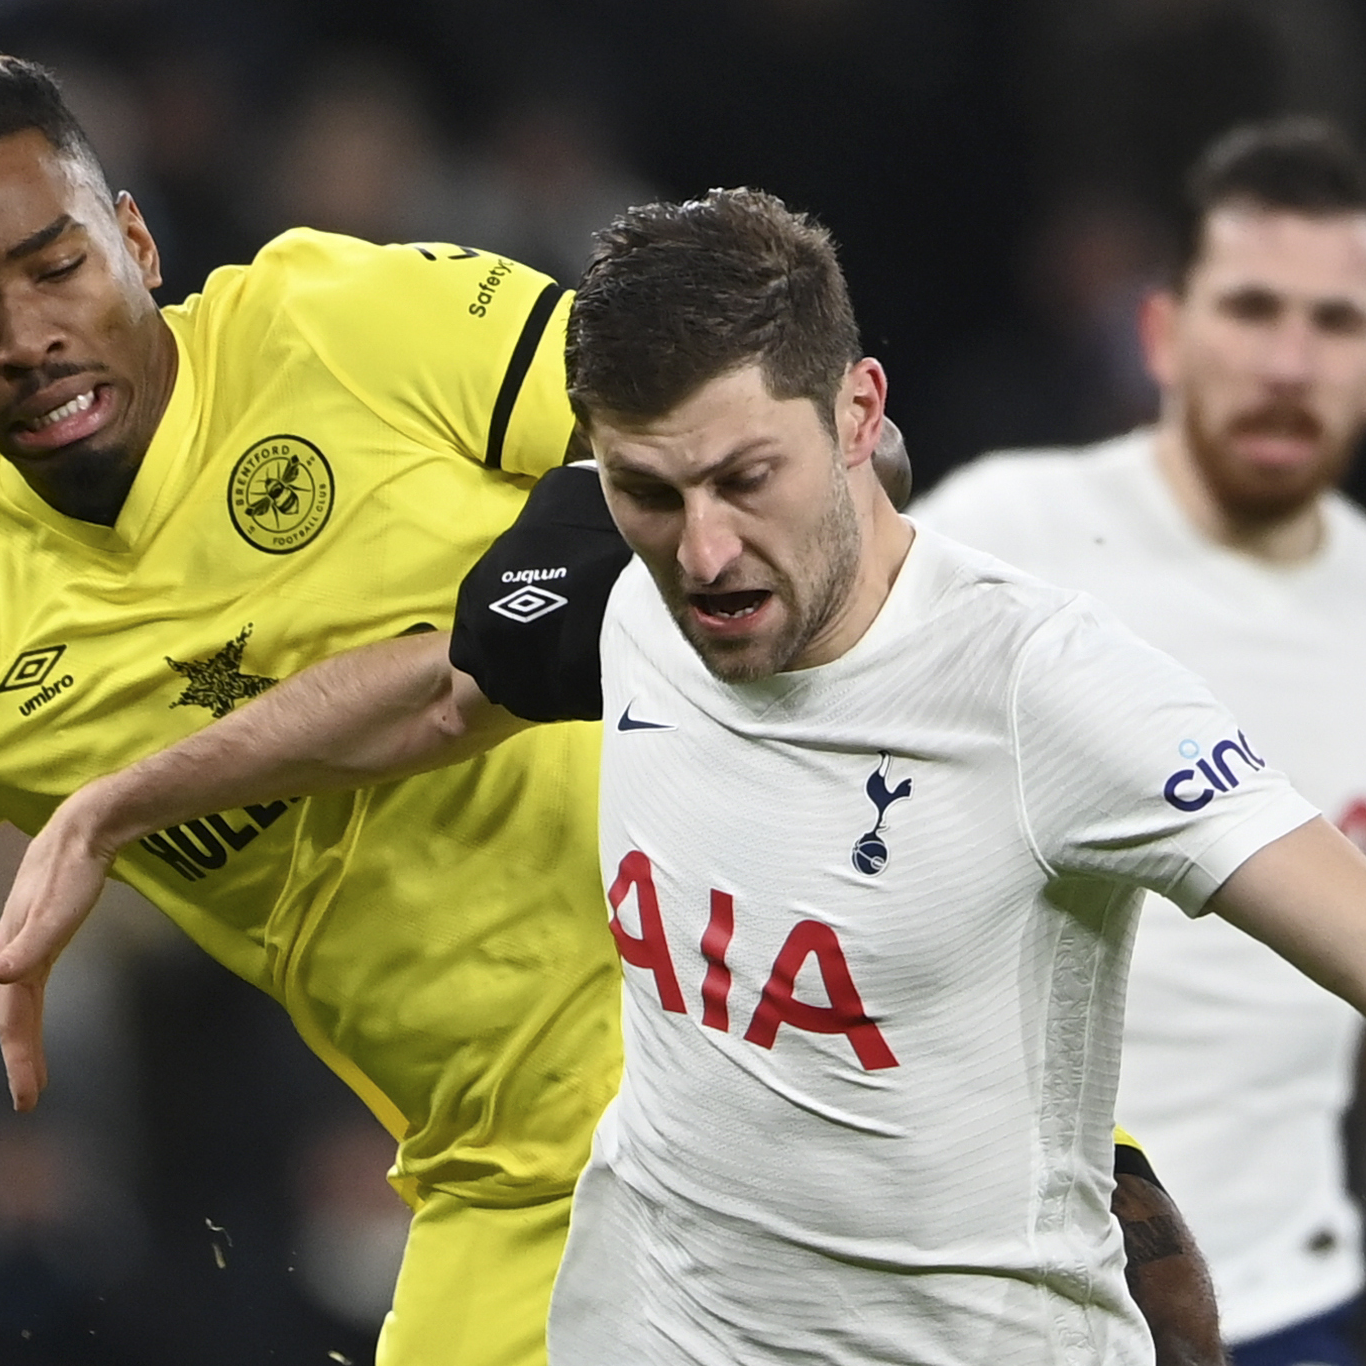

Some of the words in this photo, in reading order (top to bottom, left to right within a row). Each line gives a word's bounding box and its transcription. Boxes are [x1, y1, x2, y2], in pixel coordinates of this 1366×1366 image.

[468, 259, 514, 318] Safety
[235, 444, 290, 506] BRENTFORD
[272, 516, 319, 546] FOOTBALL
[315, 483, 327, 513] CLUB
[501, 567, 567, 584] umbro
[18, 674, 74, 717] umbro
[607, 849, 901, 1071] AIA
